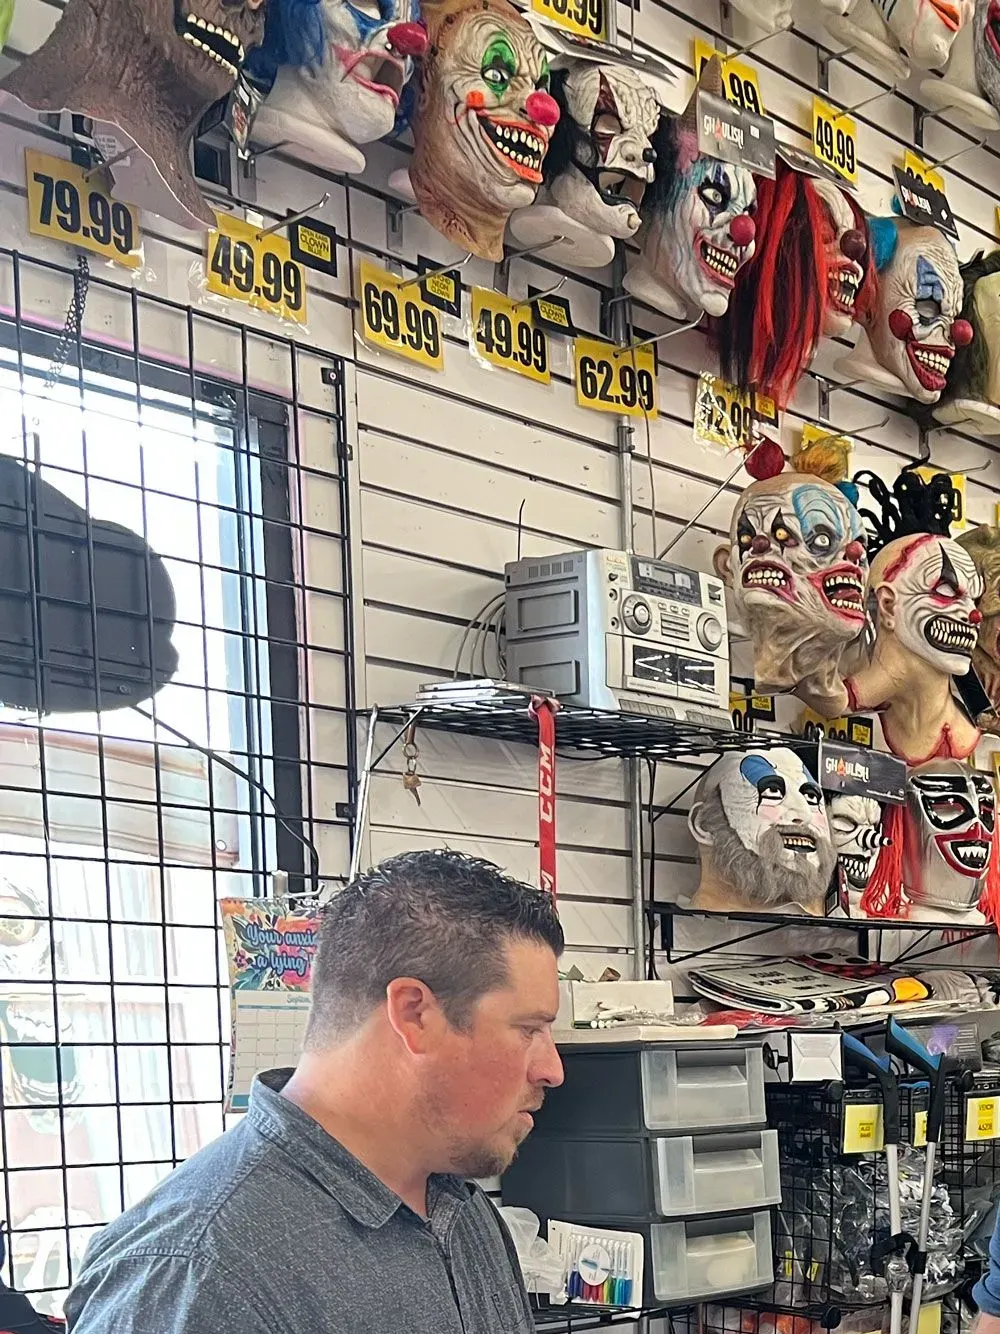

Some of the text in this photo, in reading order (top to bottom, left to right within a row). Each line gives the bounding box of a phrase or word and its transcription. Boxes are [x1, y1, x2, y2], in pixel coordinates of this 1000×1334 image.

[816, 115, 855, 174] 49.99
[34, 171, 132, 254] 79.99
[211, 234, 302, 310] 49.99
[300, 234, 328, 252] CLOWN
[364, 282, 440, 357] 69.99
[477, 308, 548, 374] 49.99
[579, 356, 653, 411] 62.99
[246, 924, 283, 948] Your
[271, 951, 308, 977] lying
